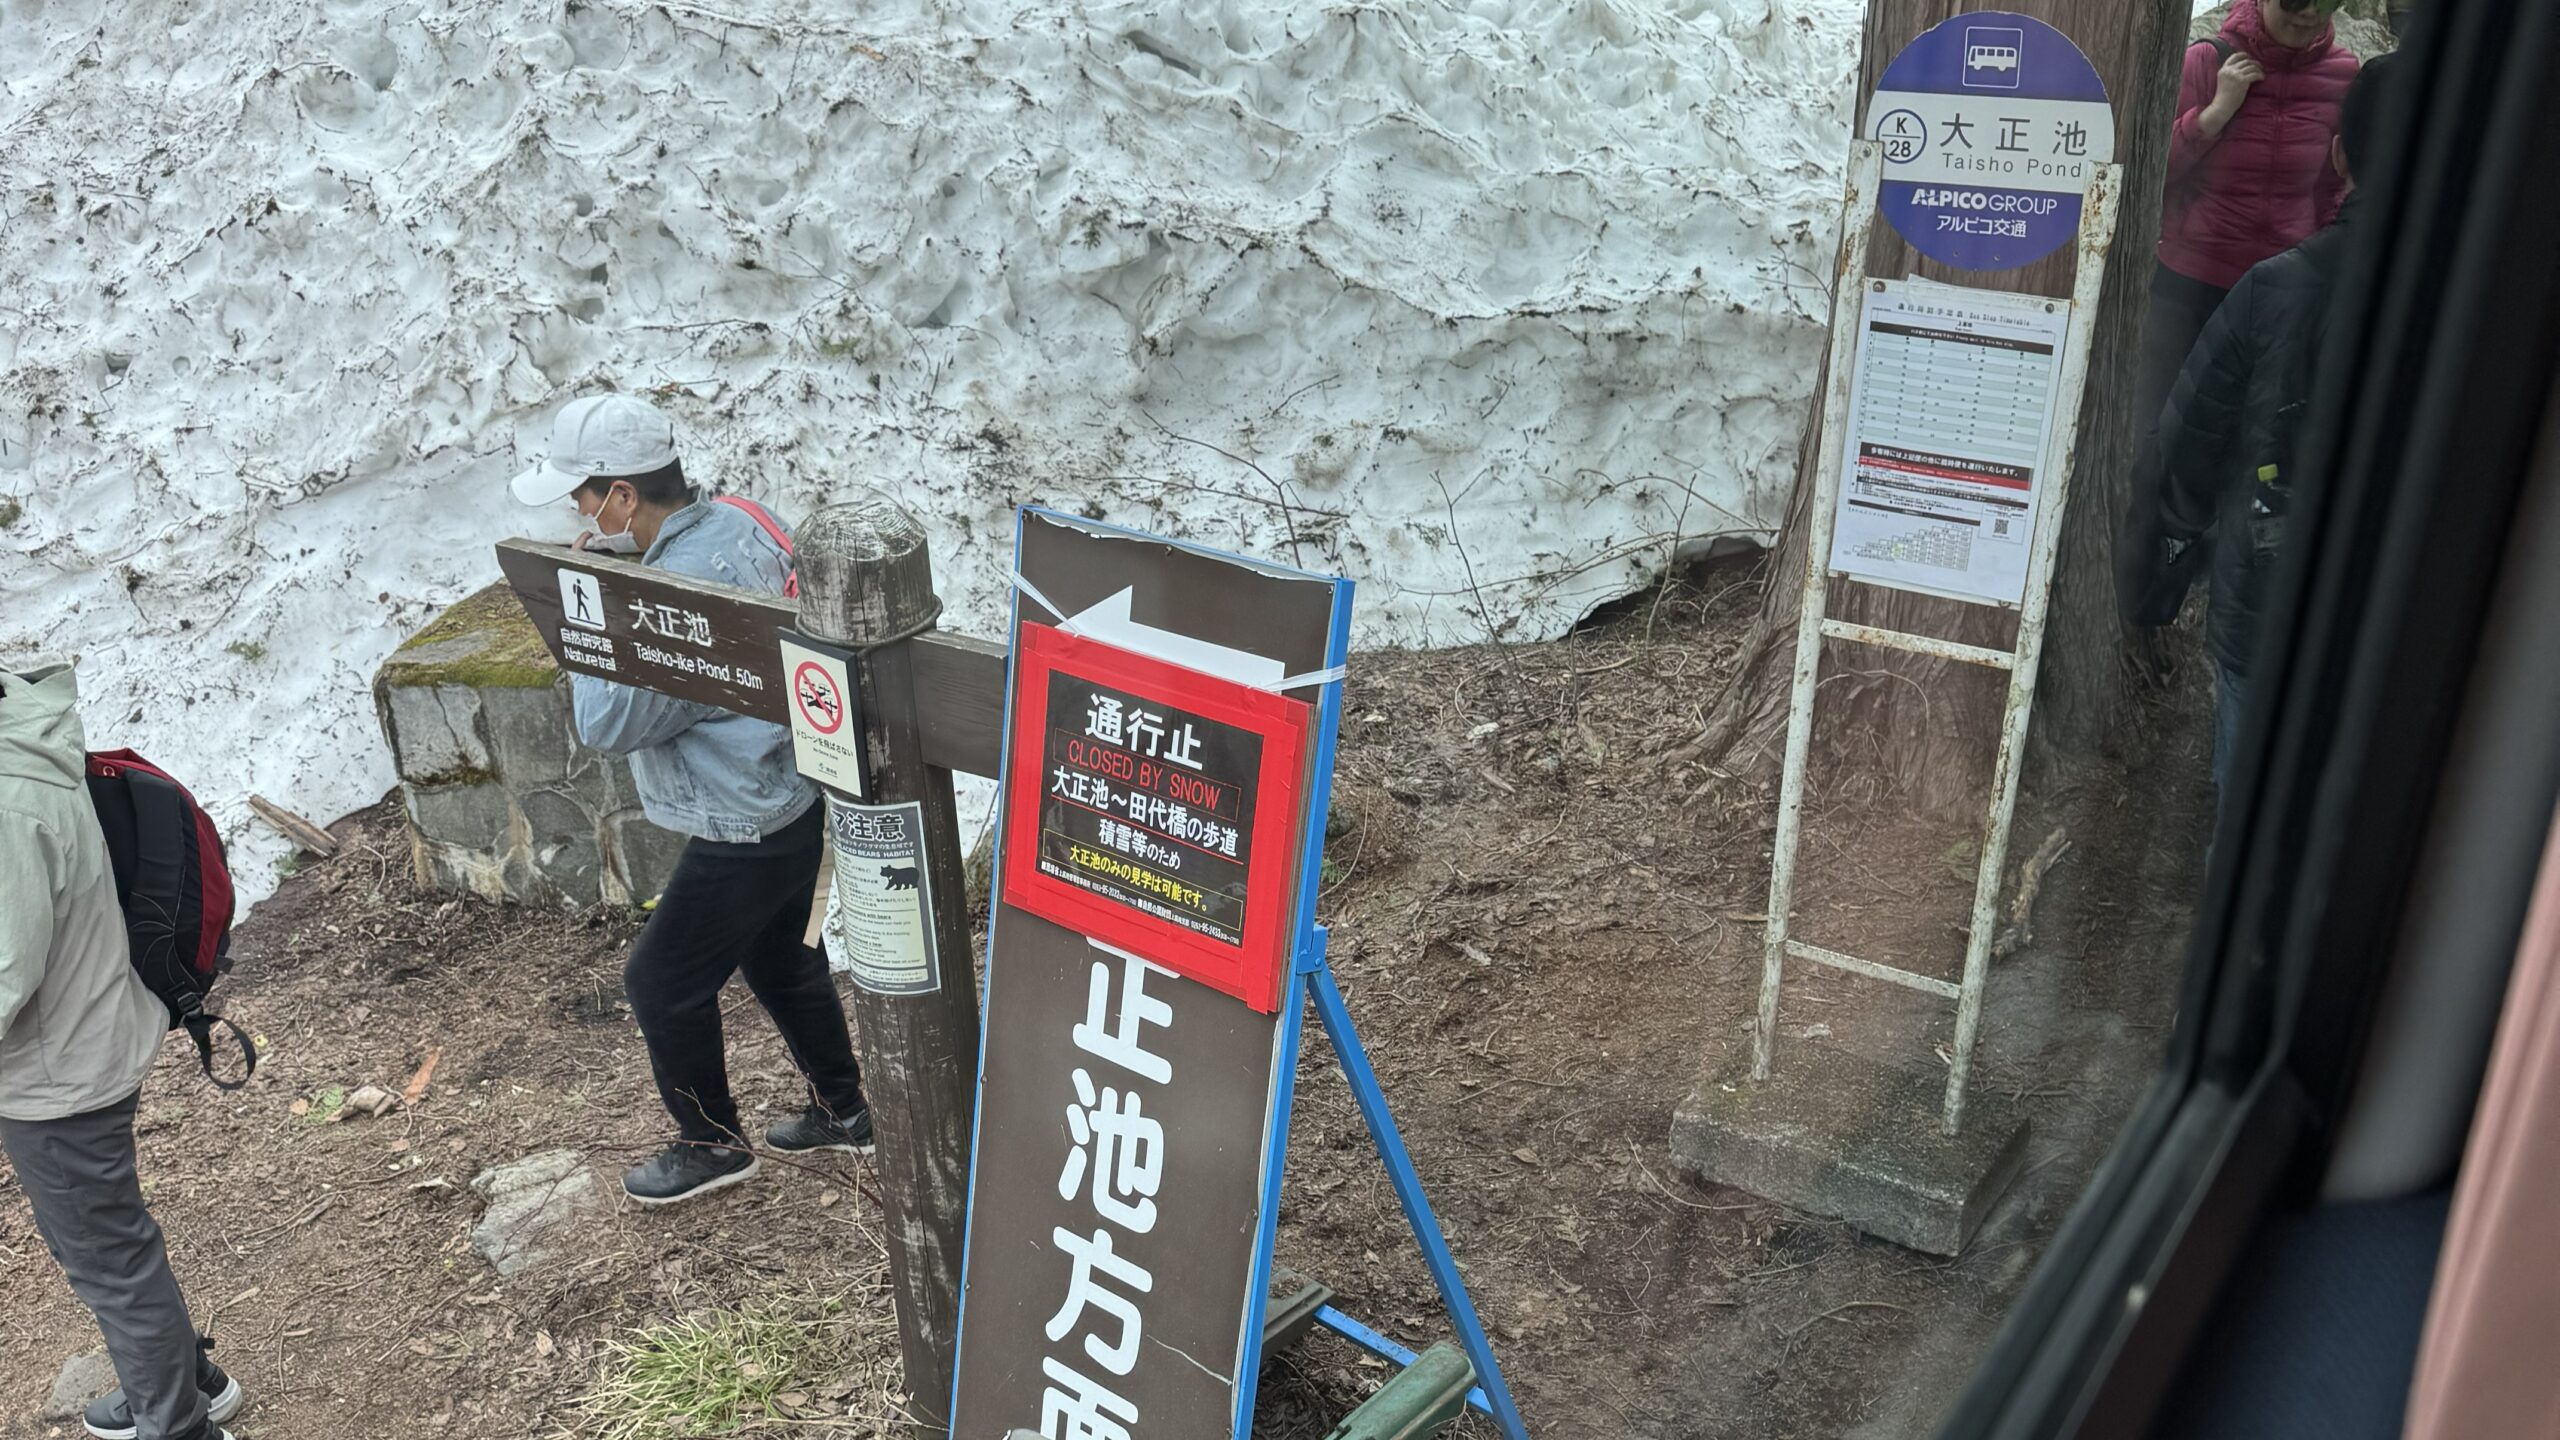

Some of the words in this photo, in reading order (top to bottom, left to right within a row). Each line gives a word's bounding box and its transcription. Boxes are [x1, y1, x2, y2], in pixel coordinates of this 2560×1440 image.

[1896, 117, 1908, 135] K
[1940, 113, 2087, 157] 大正池
[1888, 139, 1912, 158] 28
[1942, 152, 2014, 173] Taisho
[2027, 158, 2082, 178] Pond
[1936, 214, 2028, 238] アルピコ交通
[559, 626, 614, 655] 自然研究路
[628, 597, 713, 648] 大正池
[632, 641, 696, 674] Taisho-ike
[697, 656, 731, 682] Pond
[735, 667, 764, 691] 50m
[1084, 692, 1204, 771] 通行止
[1068, 739, 1134, 780] CLOSED
[1138, 762, 1164, 792] BY
[1169, 773, 1221, 812] SNOW
[883, 849, 915, 858] HABITAT
[1098, 818, 1182, 871] 積雪等のため
[1069, 844, 1208, 913] 大正池のみの見学は可能です。
